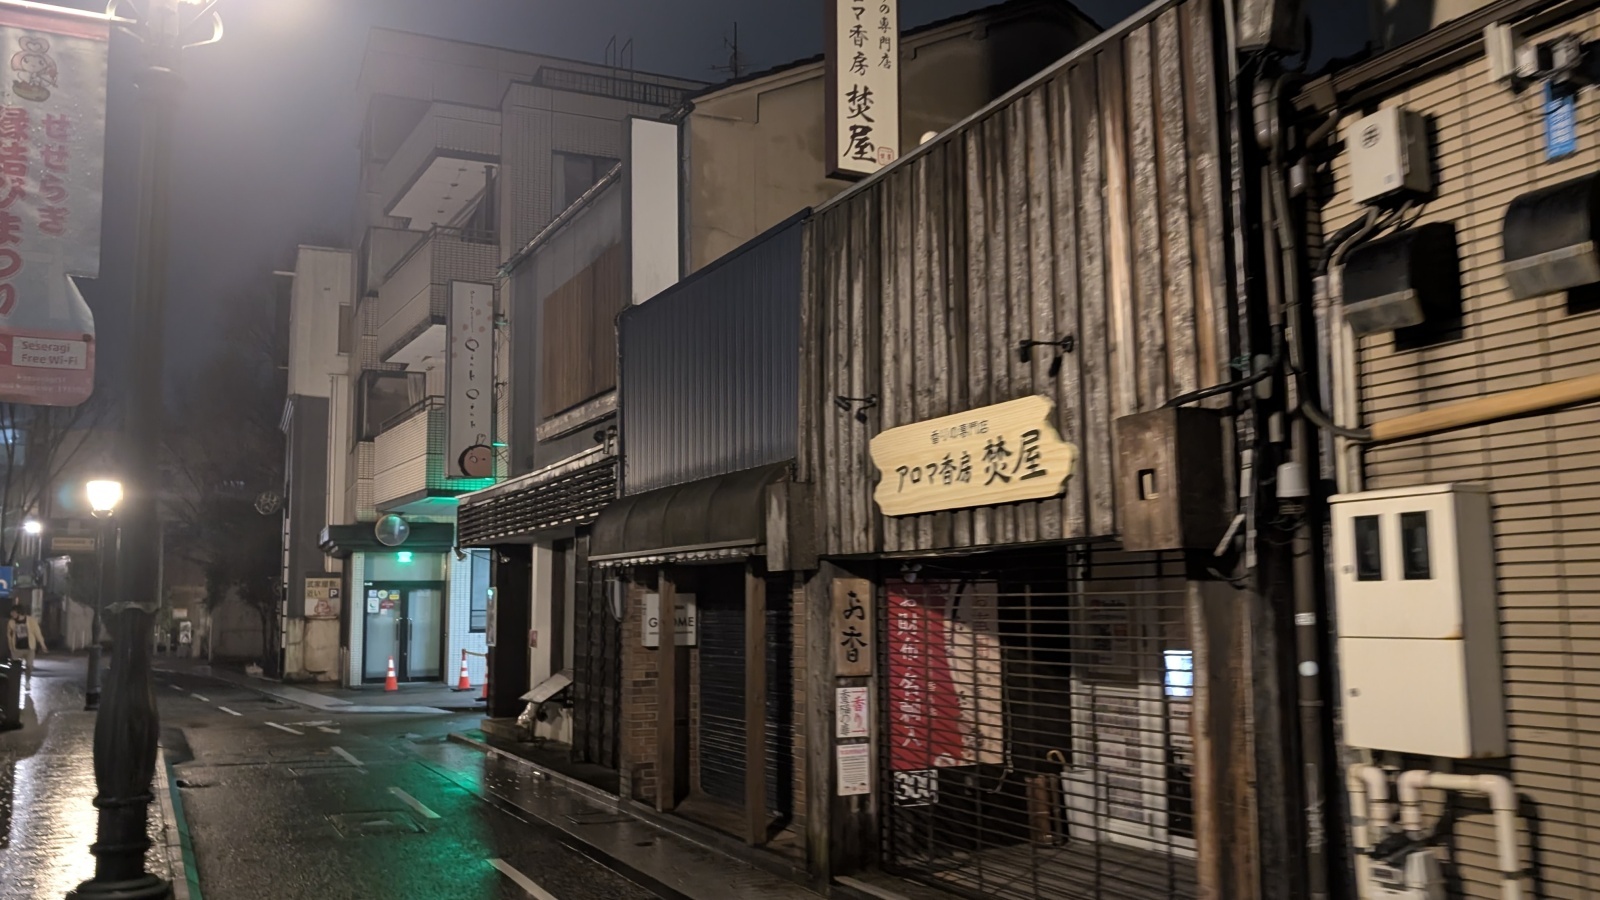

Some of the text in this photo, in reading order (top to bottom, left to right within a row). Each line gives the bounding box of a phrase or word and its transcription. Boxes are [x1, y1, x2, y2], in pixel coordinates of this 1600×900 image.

[849, 0, 869, 76] マ香房
[878, 0, 891, 69] の専門店
[38, 112, 71, 236] せせらぎ
[21, 354, 79, 366] Free Wi-Fi
[22, 341, 71, 353] Seseragi
[895, 429, 1047, 493] アロマ香房 焚屋
[930, 420, 989, 445] 香りの専門店
[841, 590, 868, 663] お香
